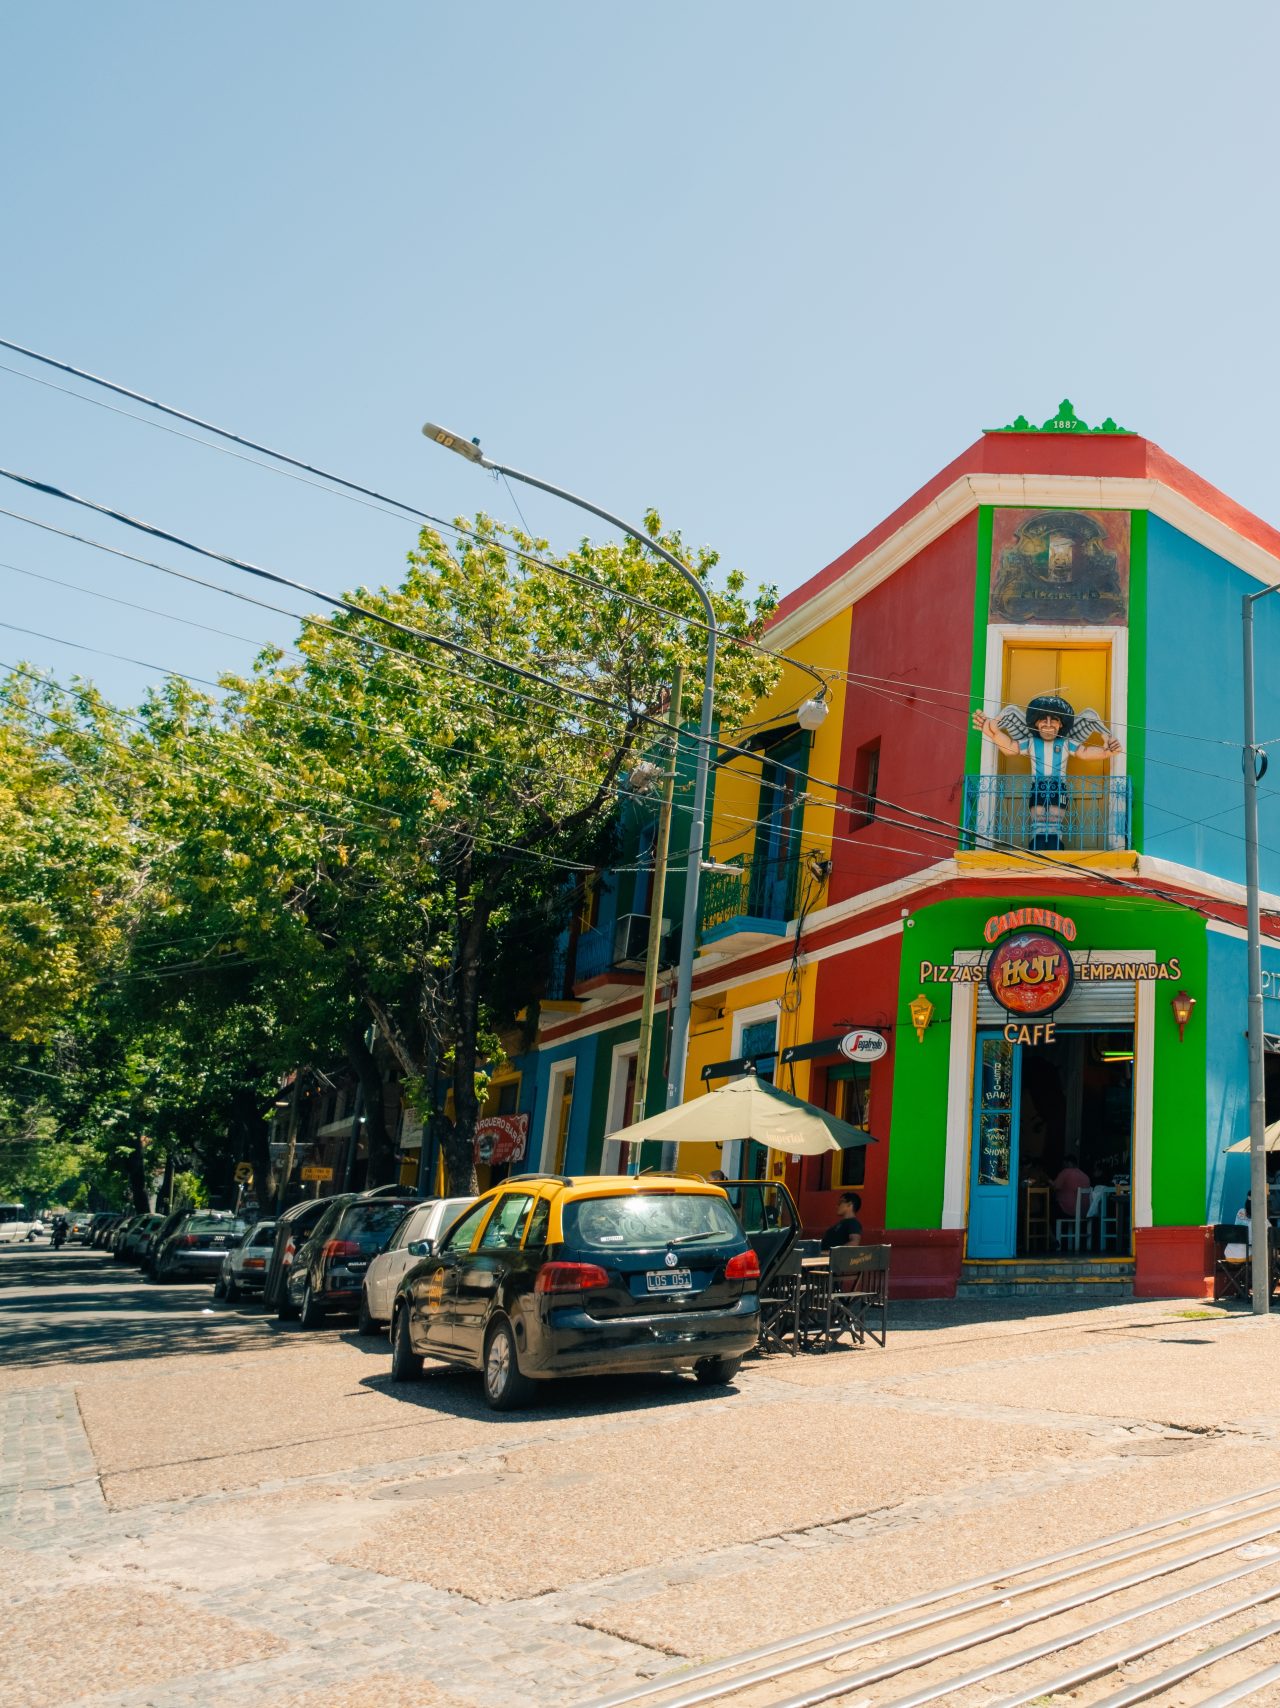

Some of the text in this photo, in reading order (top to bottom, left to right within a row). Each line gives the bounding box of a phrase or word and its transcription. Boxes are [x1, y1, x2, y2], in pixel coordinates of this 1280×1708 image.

[1053, 420, 1078, 429] 1887
[983, 907, 1077, 943] CAMINITO
[920, 961, 983, 984] PIZZAS
[1081, 958, 1182, 981] EMPANADAS
[1004, 1022, 1057, 1047] CAFE
[985, 1091, 1006, 1100] BAR
